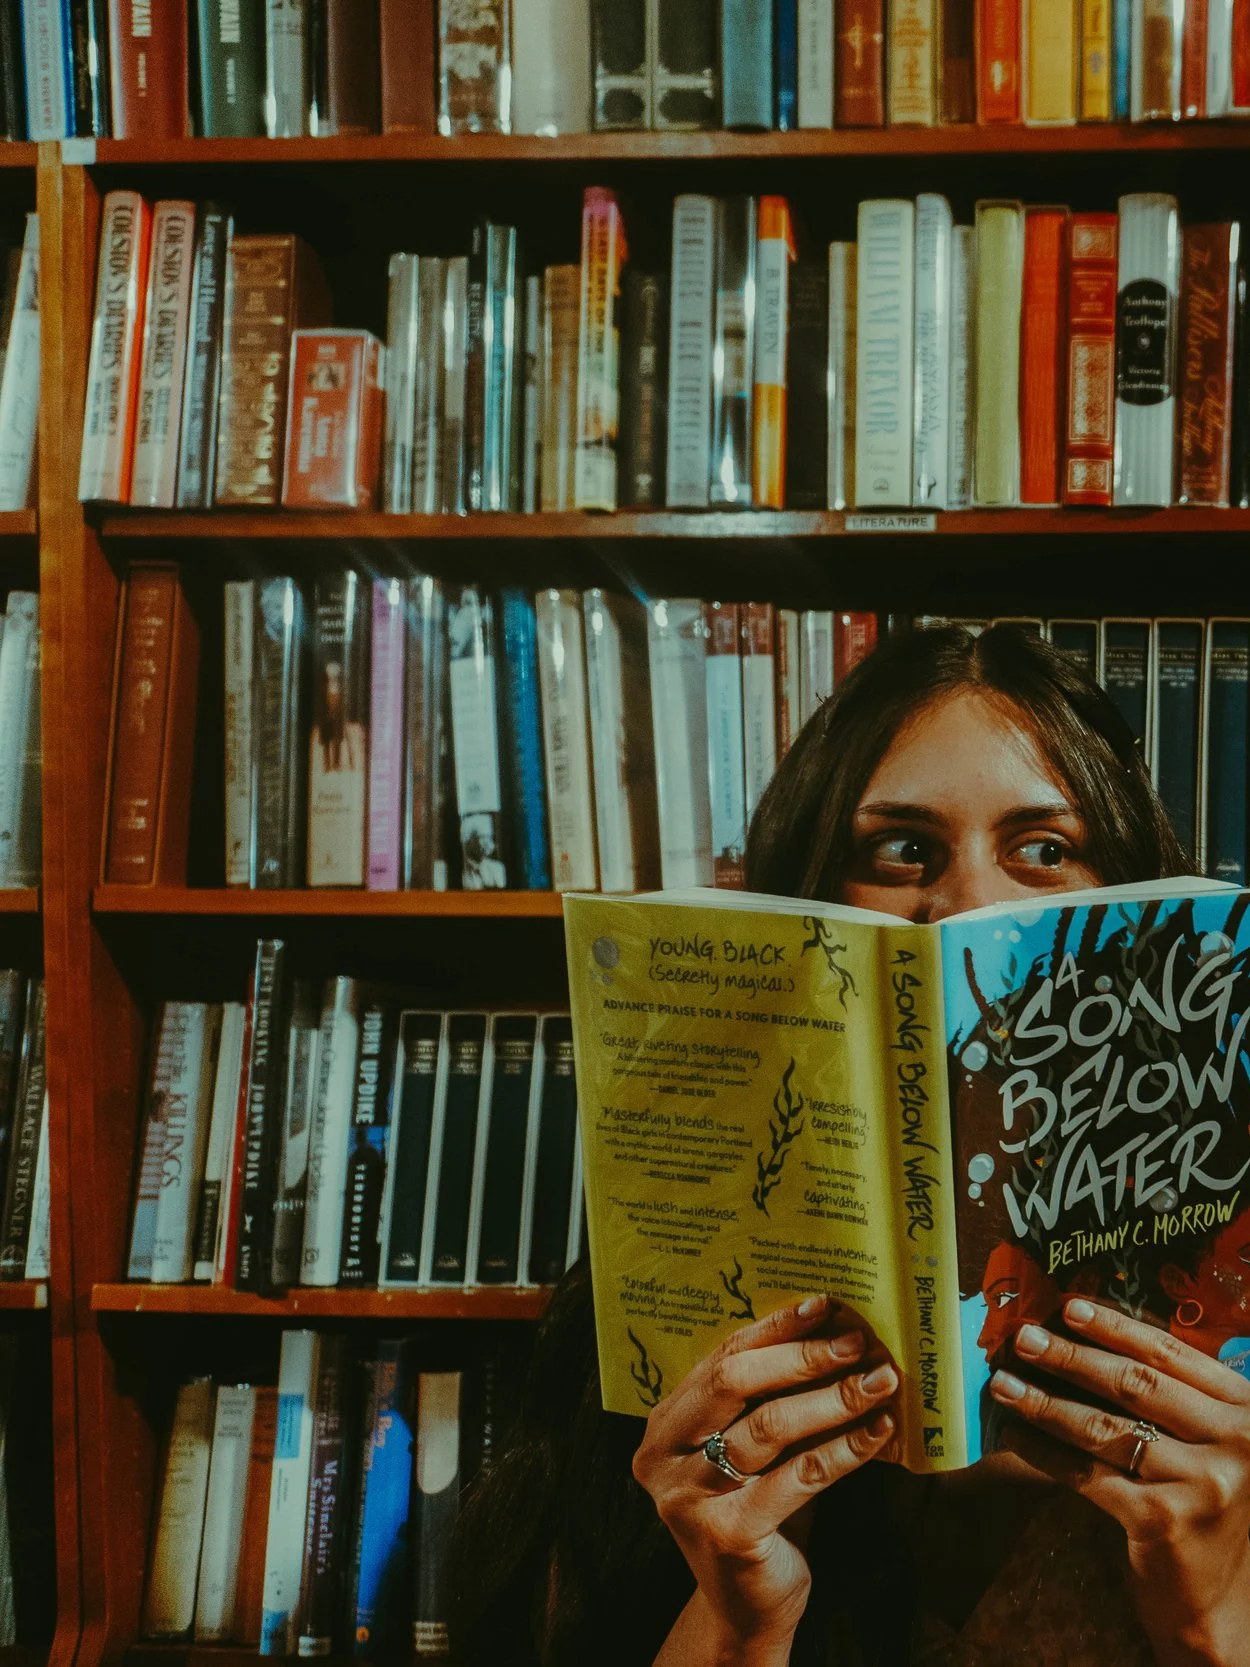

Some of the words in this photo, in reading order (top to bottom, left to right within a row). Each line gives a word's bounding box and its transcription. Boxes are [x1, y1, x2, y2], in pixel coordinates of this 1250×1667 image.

[866, 211, 902, 326] WILLIAM
[762, 288, 780, 355] TRAVEN
[1123, 314, 1168, 329] Trollope
[1124, 296, 1167, 309] Anthony
[864, 334, 900, 435] TREVOR
[1127, 366, 1161, 376] Victoria
[852, 518, 929, 528] LITERATURE
[650, 932, 719, 966] YOUNG.
[723, 940, 792, 968] BLACK.
[650, 964, 719, 996] (Secretly
[890, 948, 916, 965] A
[1053, 950, 1084, 998] A
[603, 998, 654, 1013] ADVANCE
[657, 1003, 697, 1017] PRAISE
[698, 1007, 722, 1018] FOR
[724, 1010, 733, 1019] A
[735, 1010, 768, 1023] SONG
[771, 1014, 809, 1027] BELOW
[811, 1019, 845, 1032] WATER
[890, 974, 924, 1051] SONG
[1010, 933, 1244, 1066] SONG
[360, 1010, 383, 1056] JOHN
[17, 1063, 47, 1152] WALLACE
[354, 1058, 380, 1125] UPDIKE
[898, 1062, 940, 1157] BELOW
[5, 1155, 34, 1239] STEGNER
[350, 1163, 366, 1252] TERRORIST
[902, 1150, 941, 1242] WATER
[1048, 1221, 1131, 1275] BETHANY
[1132, 1217, 1150, 1247] C.
[1153, 1190, 1242, 1246] MORROW
[914, 1275, 935, 1335] BETHANY
[916, 1336, 928, 1351] C.
[918, 1353, 943, 1415] MORROW
[321, 1458, 338, 1492] Mrs
